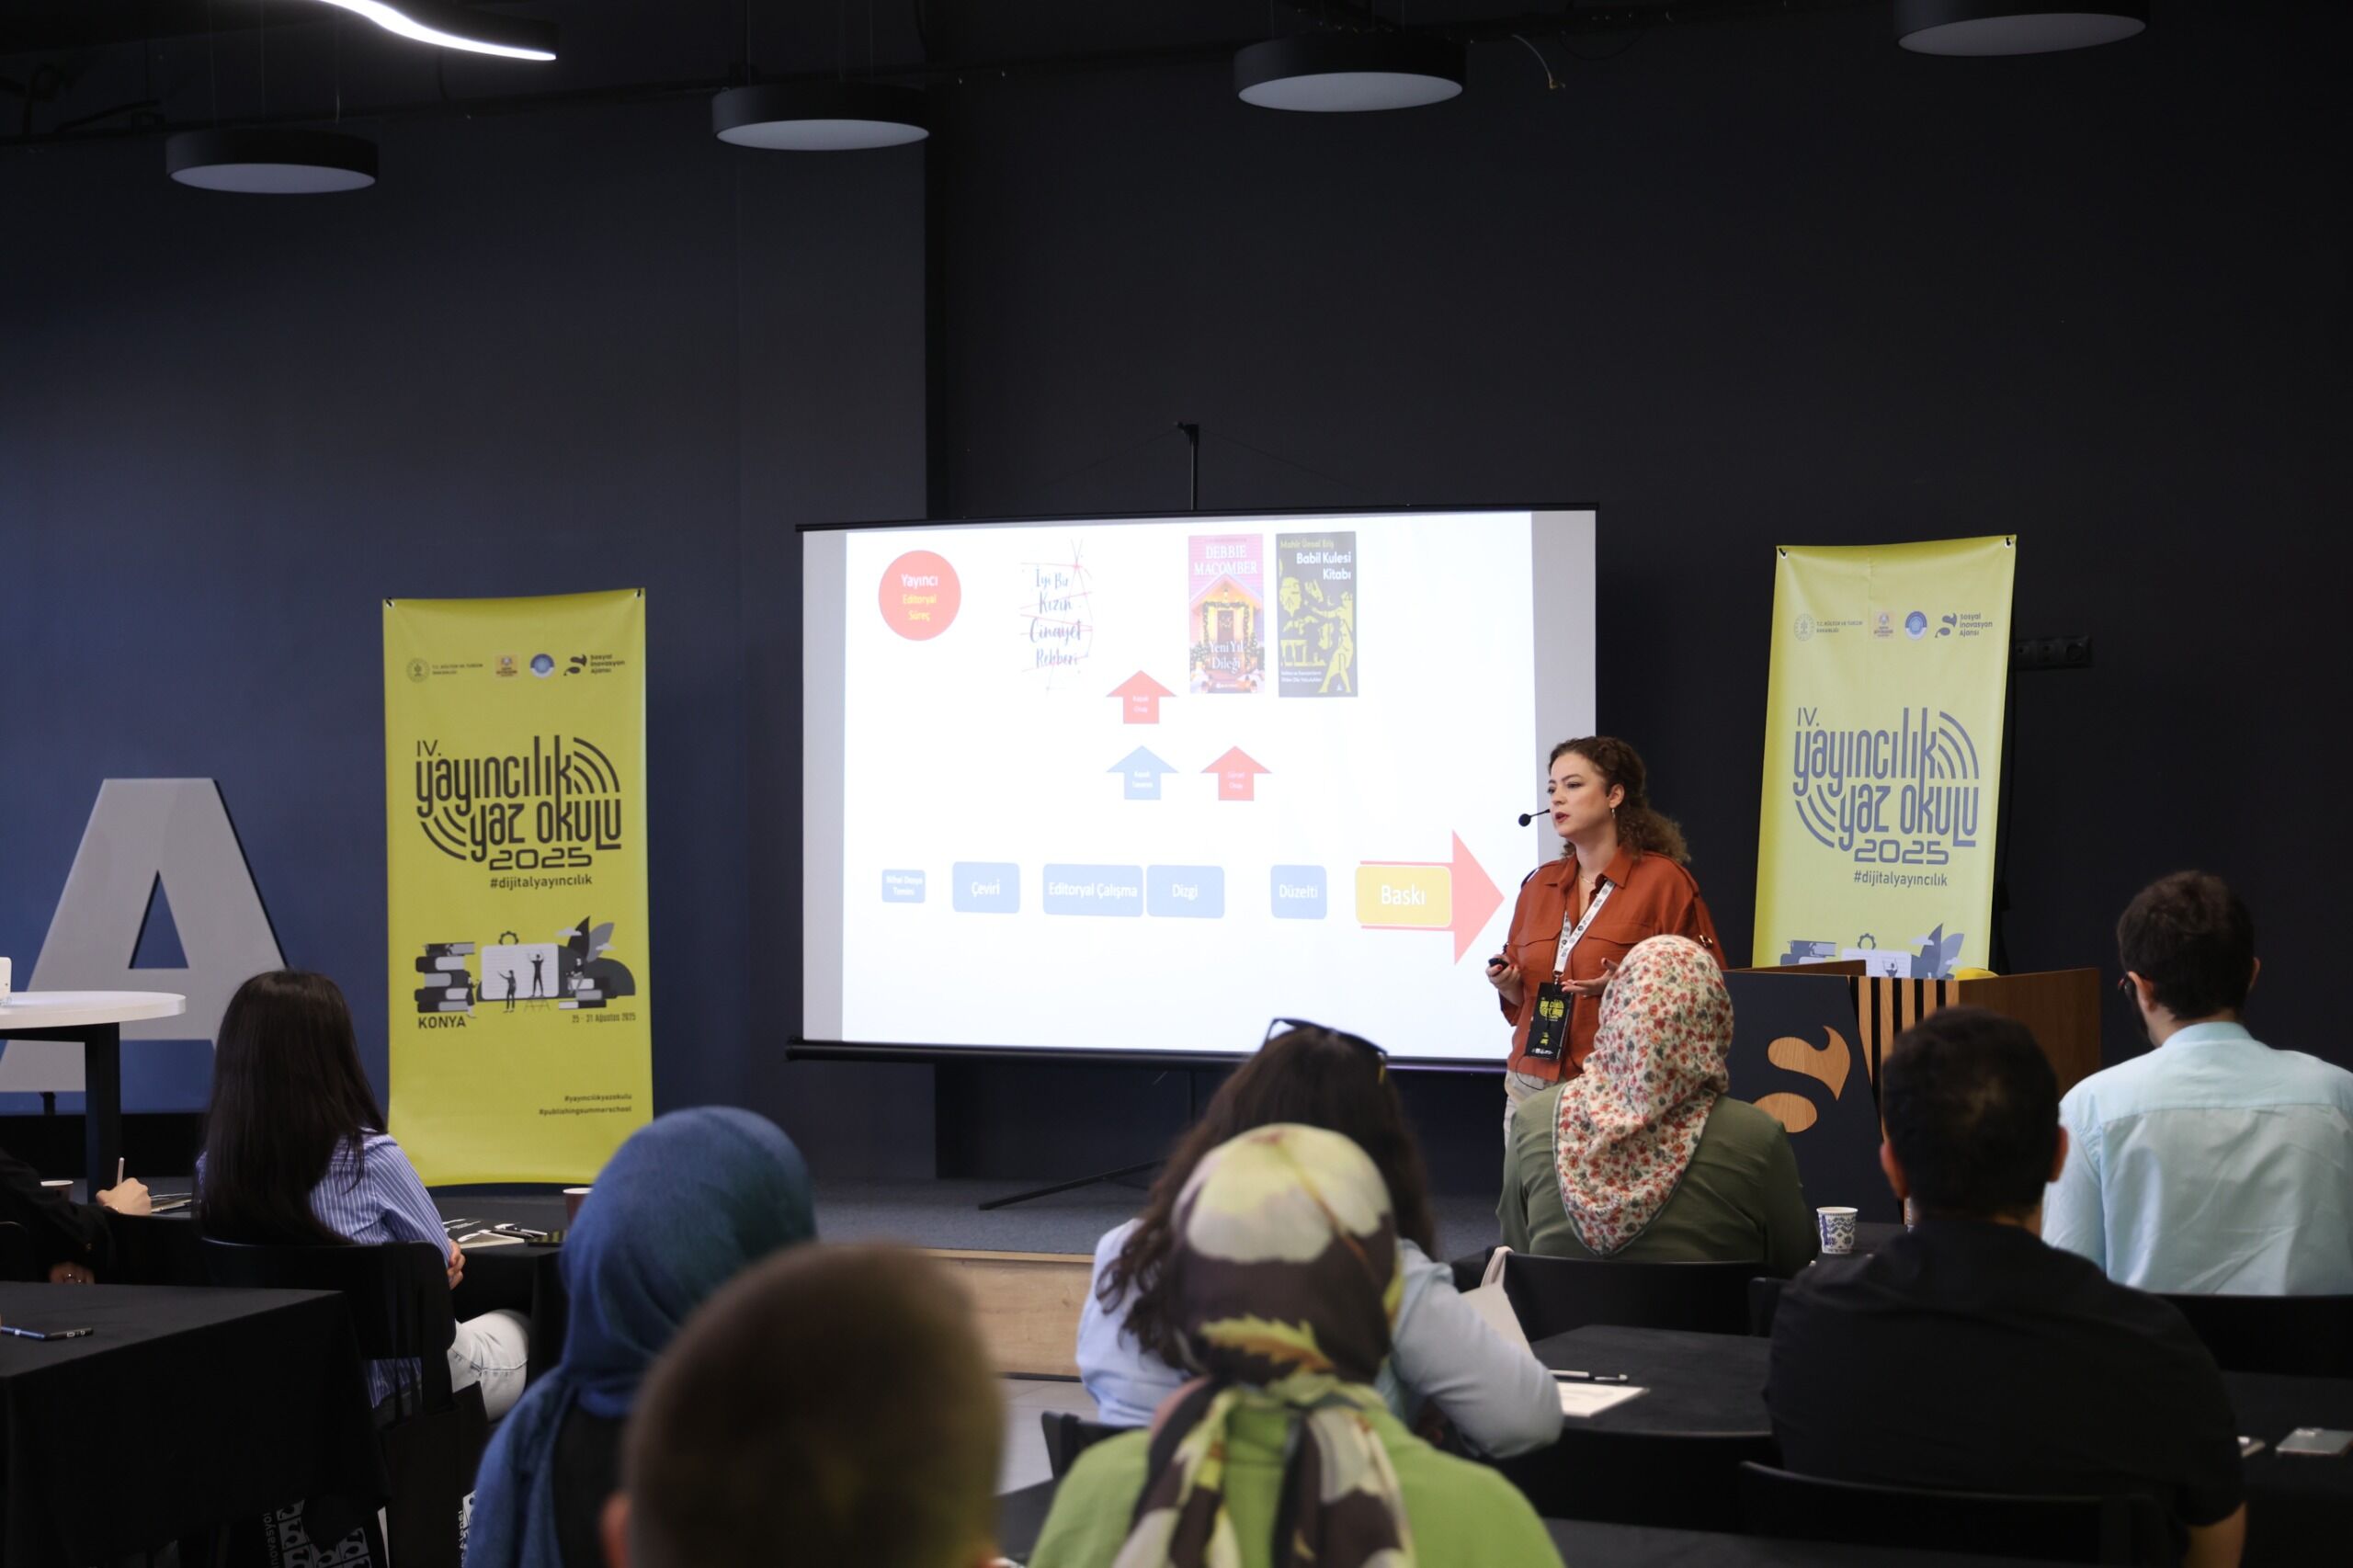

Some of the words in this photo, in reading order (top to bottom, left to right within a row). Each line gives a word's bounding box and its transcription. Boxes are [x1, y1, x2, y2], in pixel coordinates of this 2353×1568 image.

[1205, 544, 1246, 559] DEBBIE
[1296, 551, 1321, 564] Babil
[1323, 551, 1351, 563] Kulesi
[1195, 560, 1257, 575] MACOMBER
[1323, 568, 1351, 580] Kitabı
[901, 574, 938, 589] Yayıncı
[903, 594, 937, 607] Editoryal
[908, 610, 930, 622] Süreç
[1029, 617, 1082, 643] Cinayet
[1210, 641, 1229, 653] Yeni
[1211, 657, 1241, 674] Dileği
[1797, 707, 1820, 727] IV.
[416, 740, 442, 756] IV.
[1793, 707, 1937, 797] yayıncılık
[416, 735, 572, 818] yayıncılık
[1838, 784, 1891, 852] yaz
[470, 803, 525, 862] yaz
[489, 847, 592, 870] 2025
[1854, 838, 1949, 865] 2025
[490, 873, 592, 891] #dijitalyayıncılık
[1854, 869, 1948, 889] #dijitalyayıncılık
[1048, 881, 1094, 899] Editoryal
[1097, 882, 1138, 900] Çalışma
[1172, 883, 1199, 900] Dizgi
[1279, 883, 1318, 900] Düzelti
[1381, 884, 1425, 905] Baskı
[0, 778, 290, 1092] A
[418, 1016, 466, 1029] KONYA
